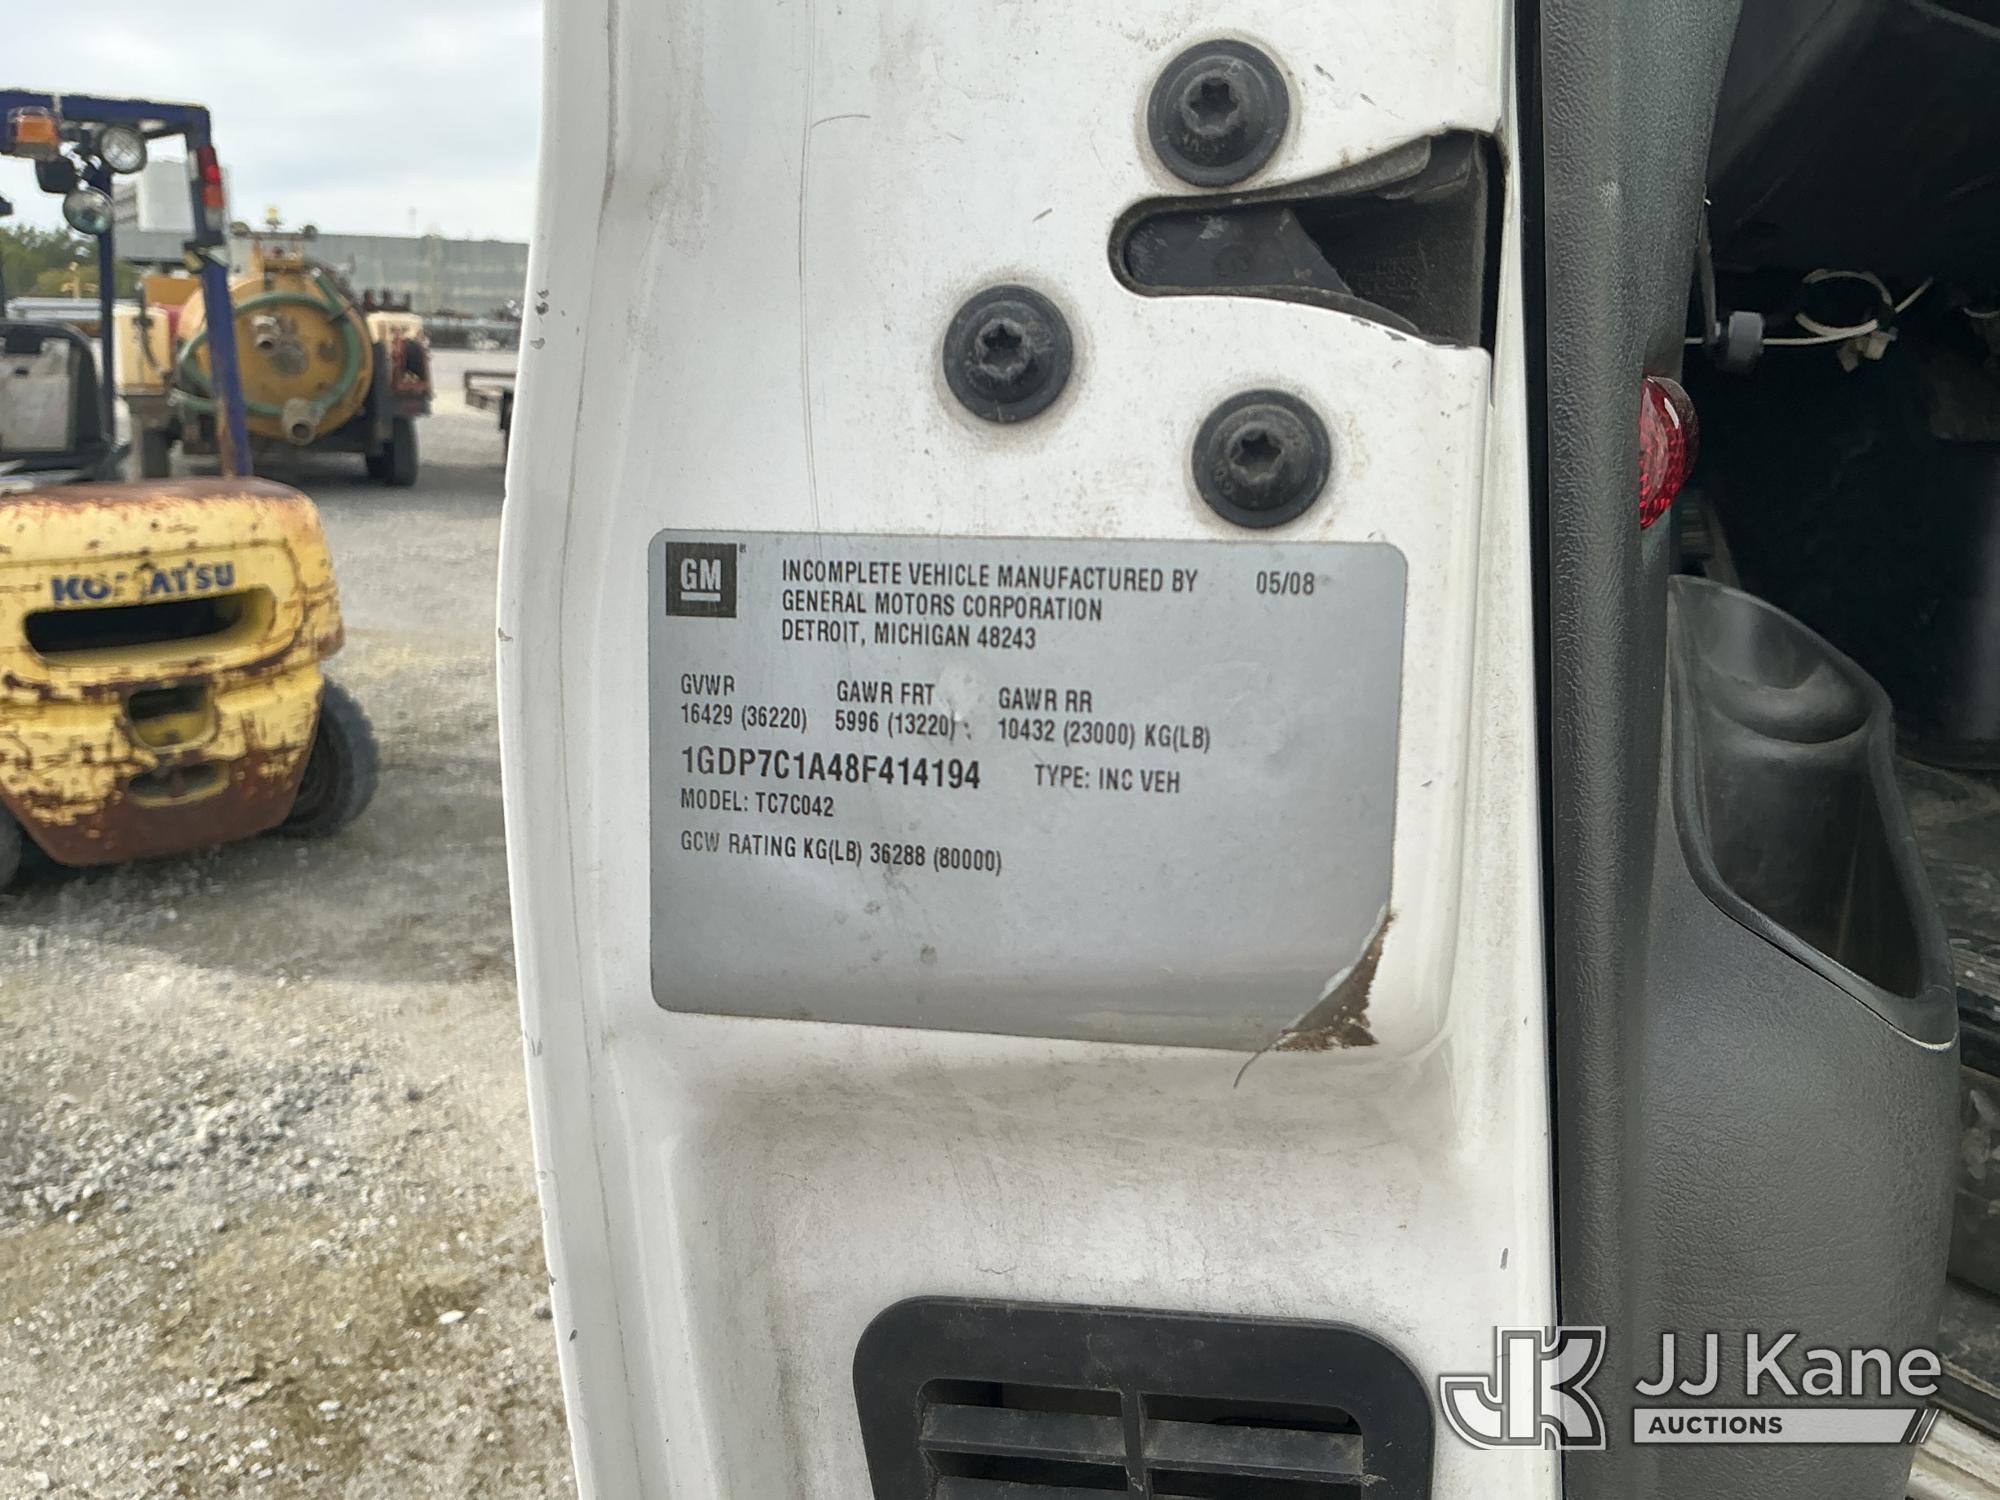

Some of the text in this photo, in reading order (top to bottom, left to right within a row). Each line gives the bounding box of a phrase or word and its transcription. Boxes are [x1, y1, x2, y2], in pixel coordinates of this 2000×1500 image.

[680, 558, 721, 590] GM
[782, 559, 1197, 592] INCOMPLETE VEHICLE MANUFACTURED BY
[1256, 571, 1315, 595] 05/08
[782, 589, 1101, 620] GENERAL MOTORS CORPORATION
[782, 618, 1036, 649] DETROIT, MICHIGAN 48243
[681, 673, 735, 696] GVWR
[837, 680, 935, 705] GAWR FRT
[999, 687, 1093, 712] GAWR RR
[681, 703, 807, 734] 16429 (36220)
[835, 709, 955, 741] 5996 (13220)
[998, 717, 1211, 754] 10432 (23000) KG(LB)
[682, 745, 980, 789] 1GDP7C1A48F414194
[1034, 763, 1180, 793] TYPE: INC VEH
[681, 787, 834, 817] MODEL: TC7C042
[681, 830, 1002, 876] GCW RATING KG(LB) 36288 (80000)
